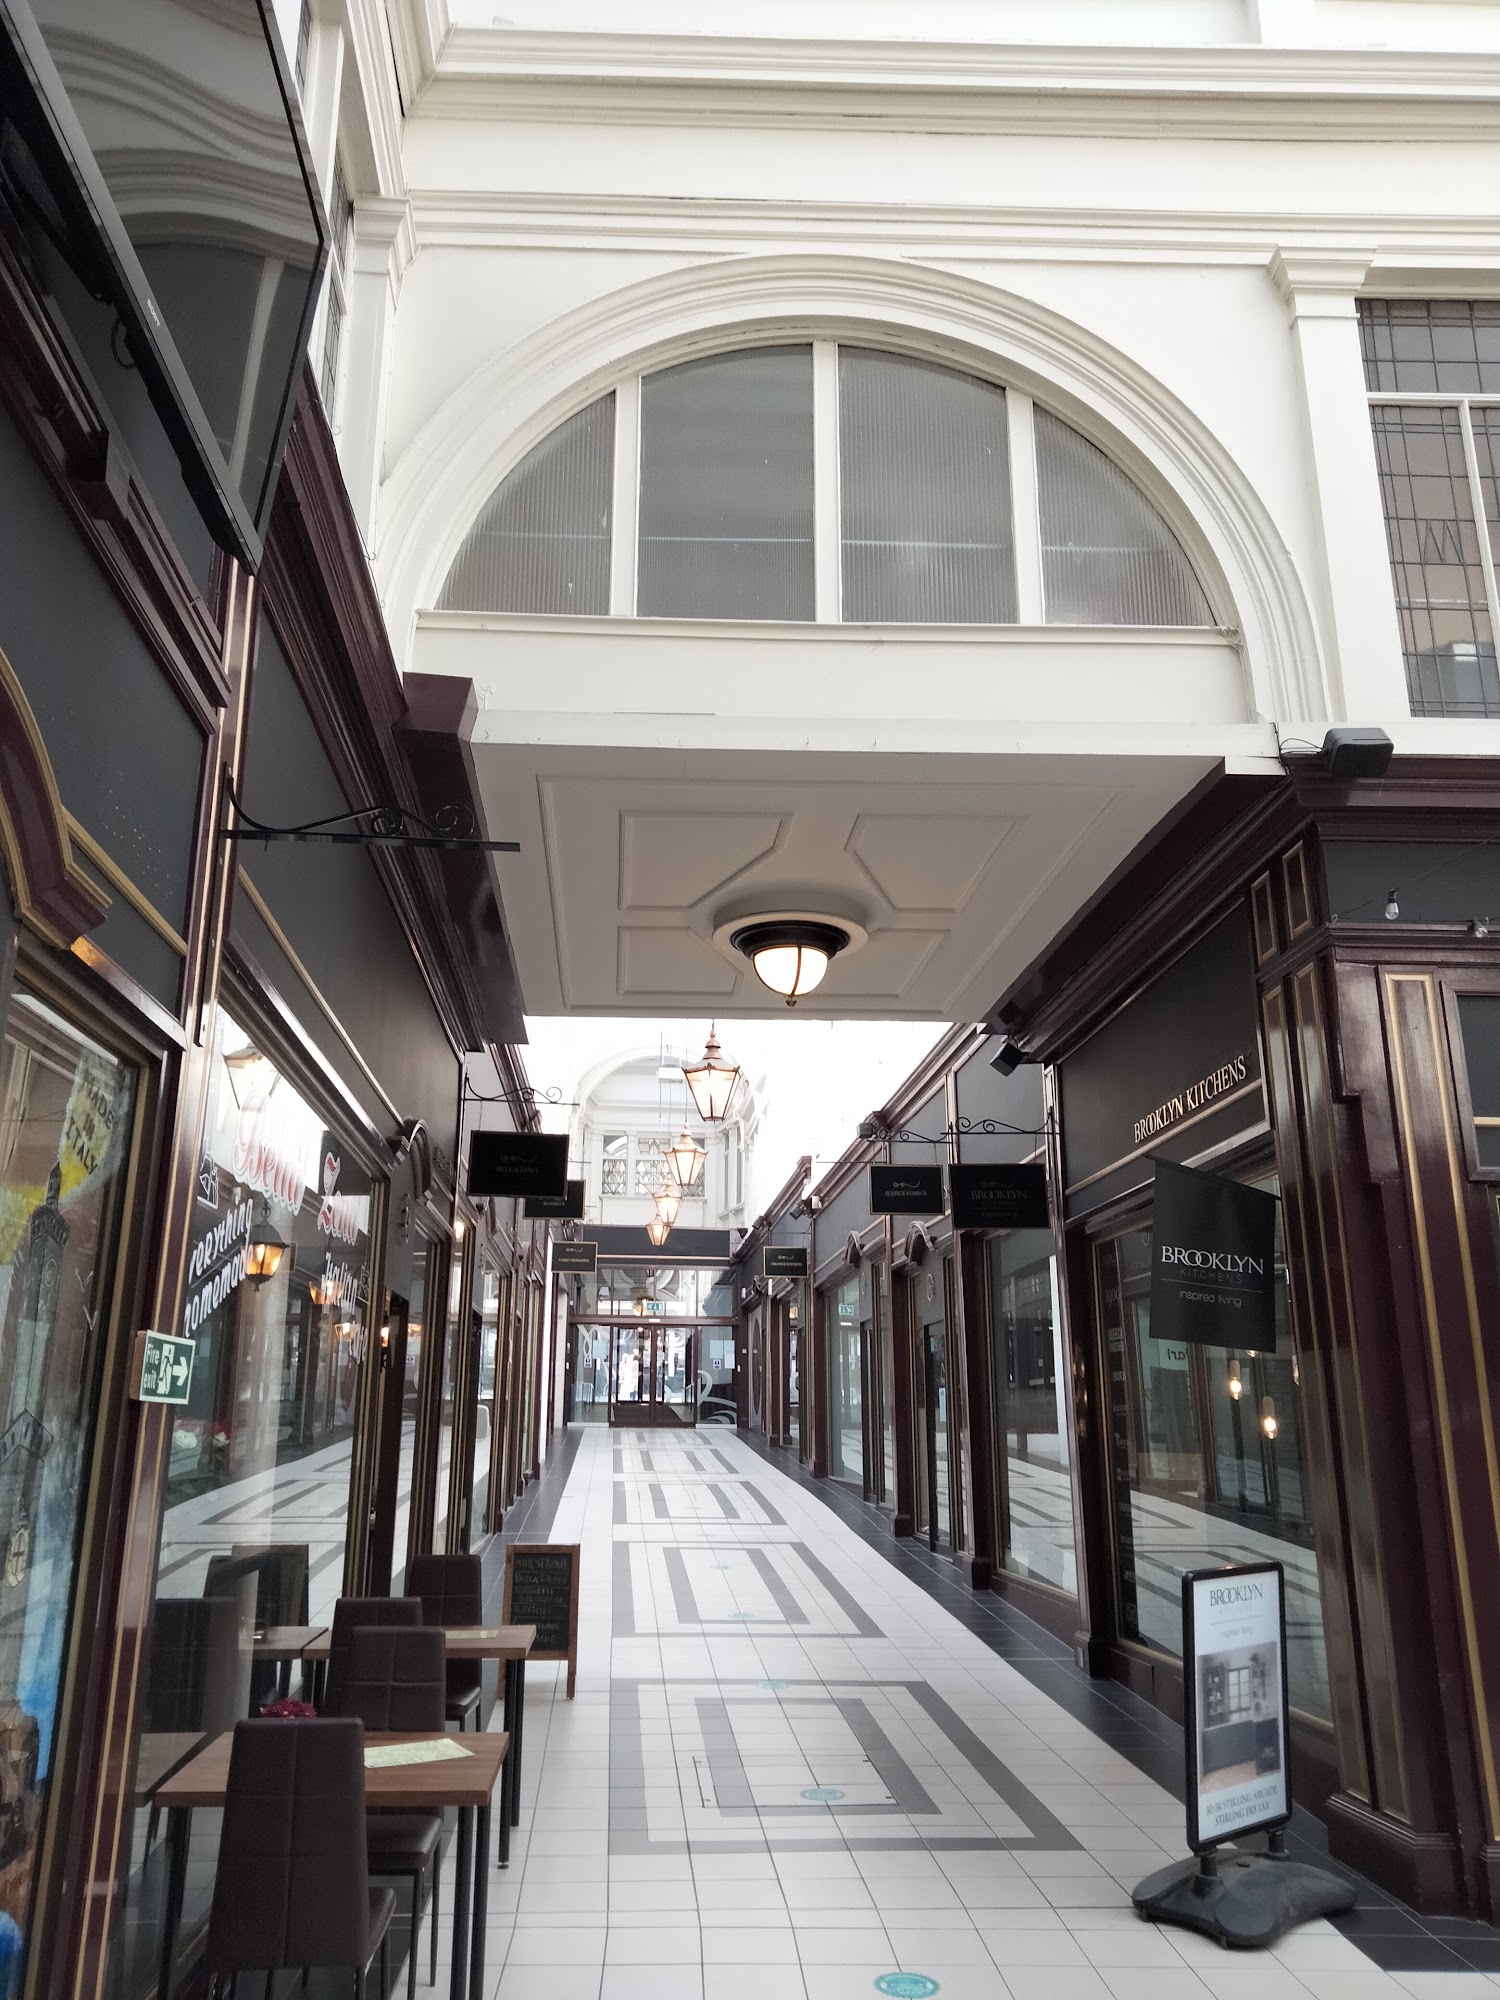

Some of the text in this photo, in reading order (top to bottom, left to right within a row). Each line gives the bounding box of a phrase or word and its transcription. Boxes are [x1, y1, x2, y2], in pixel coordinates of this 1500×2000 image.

[83, 1077, 114, 1130] MADE
[1134, 1054, 1247, 1144] BROOKLYN KITCHENS
[66, 1116, 98, 1174] ITALY
[970, 1189, 1028, 1200] BROOKLYN
[1161, 1245, 1264, 1275] BROOKLYN
[1180, 1267, 1242, 1284] KITCHENS
[1179, 1288, 1242, 1308] inspired living
[146, 1343, 160, 1365] Fire
[143, 1369, 157, 1389] exit
[1209, 1583, 1263, 1606] BROOKLYN
